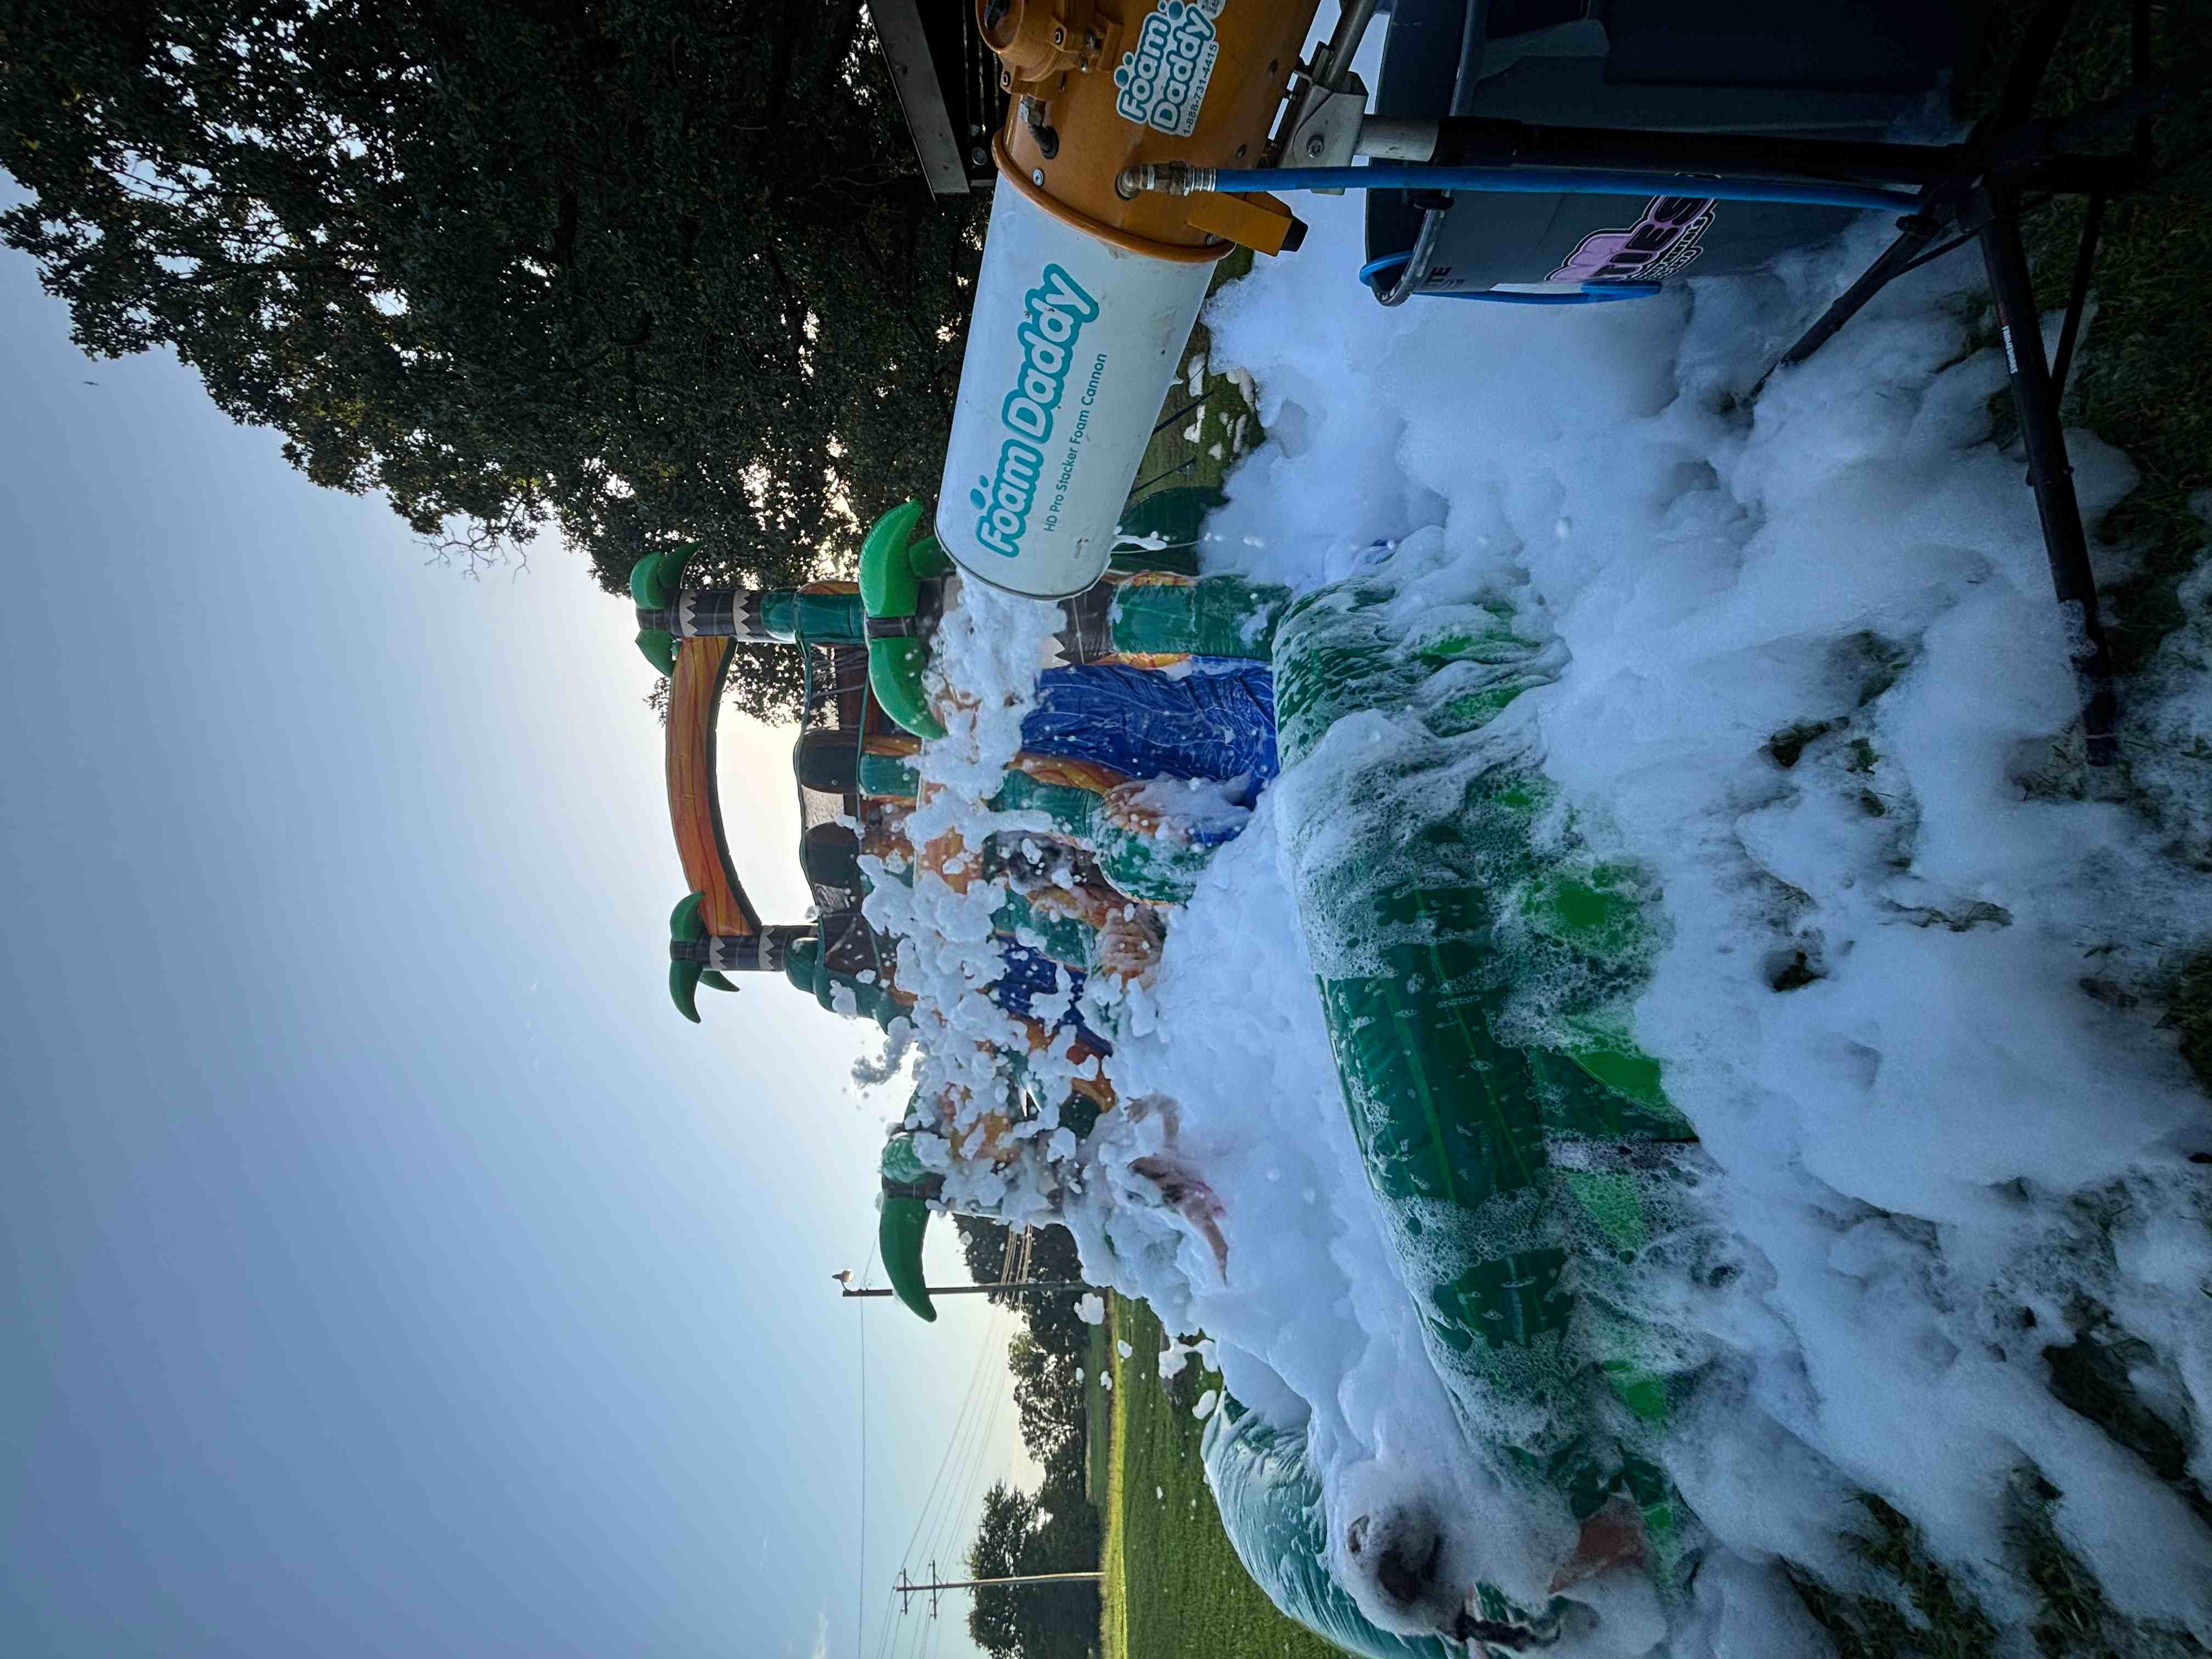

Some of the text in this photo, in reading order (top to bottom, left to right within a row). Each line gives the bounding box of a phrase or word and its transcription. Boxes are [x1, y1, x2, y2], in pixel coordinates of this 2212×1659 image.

[1119, 15, 1171, 121] Foam
[1150, 6, 1214, 131] Daddy
[1183, 44, 1218, 135] 1-888-731-4415
[2002, 325, 2018, 374] FRAMEWORKS
[975, 263, 1099, 558] Foam Daddy
[1045, 353, 1107, 532] HD Pro Stacker Foam Cannon
